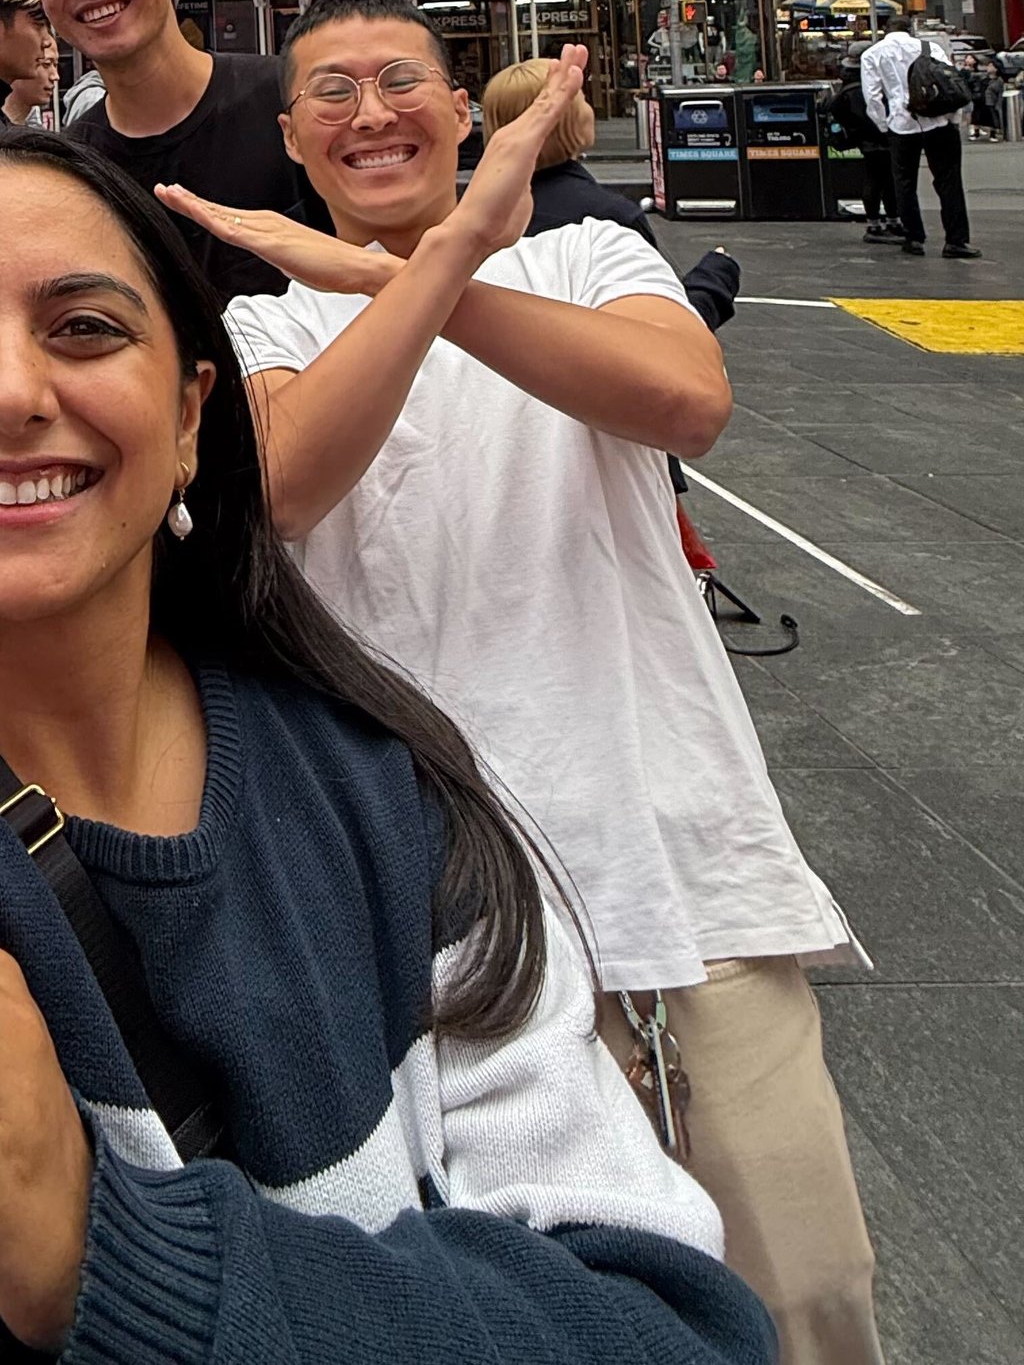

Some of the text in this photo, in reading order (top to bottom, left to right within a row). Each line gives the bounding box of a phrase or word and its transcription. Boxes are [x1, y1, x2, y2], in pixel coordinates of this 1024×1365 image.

[432, 14, 487, 27] XPRESS
[669, 148, 737, 159] TIMES SQUARE
[748, 147, 818, 158] TIMES SQUARE
